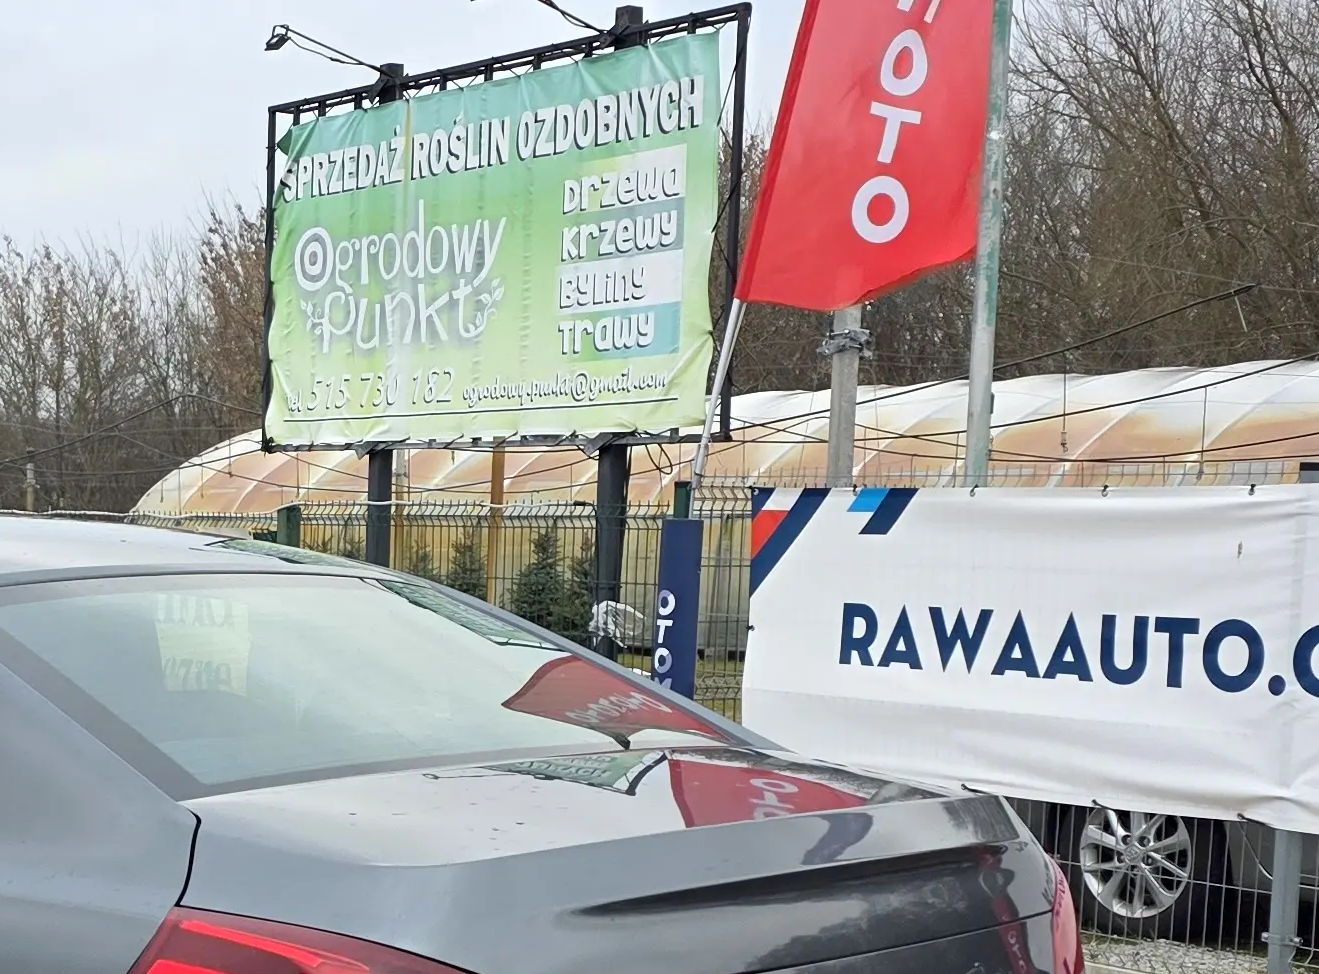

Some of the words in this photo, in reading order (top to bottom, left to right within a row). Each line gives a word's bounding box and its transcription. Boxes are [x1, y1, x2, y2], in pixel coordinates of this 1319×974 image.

[281, 126, 407, 203] SPRZEDAŻ
[410, 114, 510, 181] ROŚLIN
[517, 76, 704, 160] OZDOBNYCH
[294, 199, 507, 293] Ogrodowy
[306, 373, 352, 411] 515
[359, 370, 401, 408] 730
[411, 365, 455, 405] 182
[463, 367, 668, 408] ogrodowy.punkt@gmail.com
